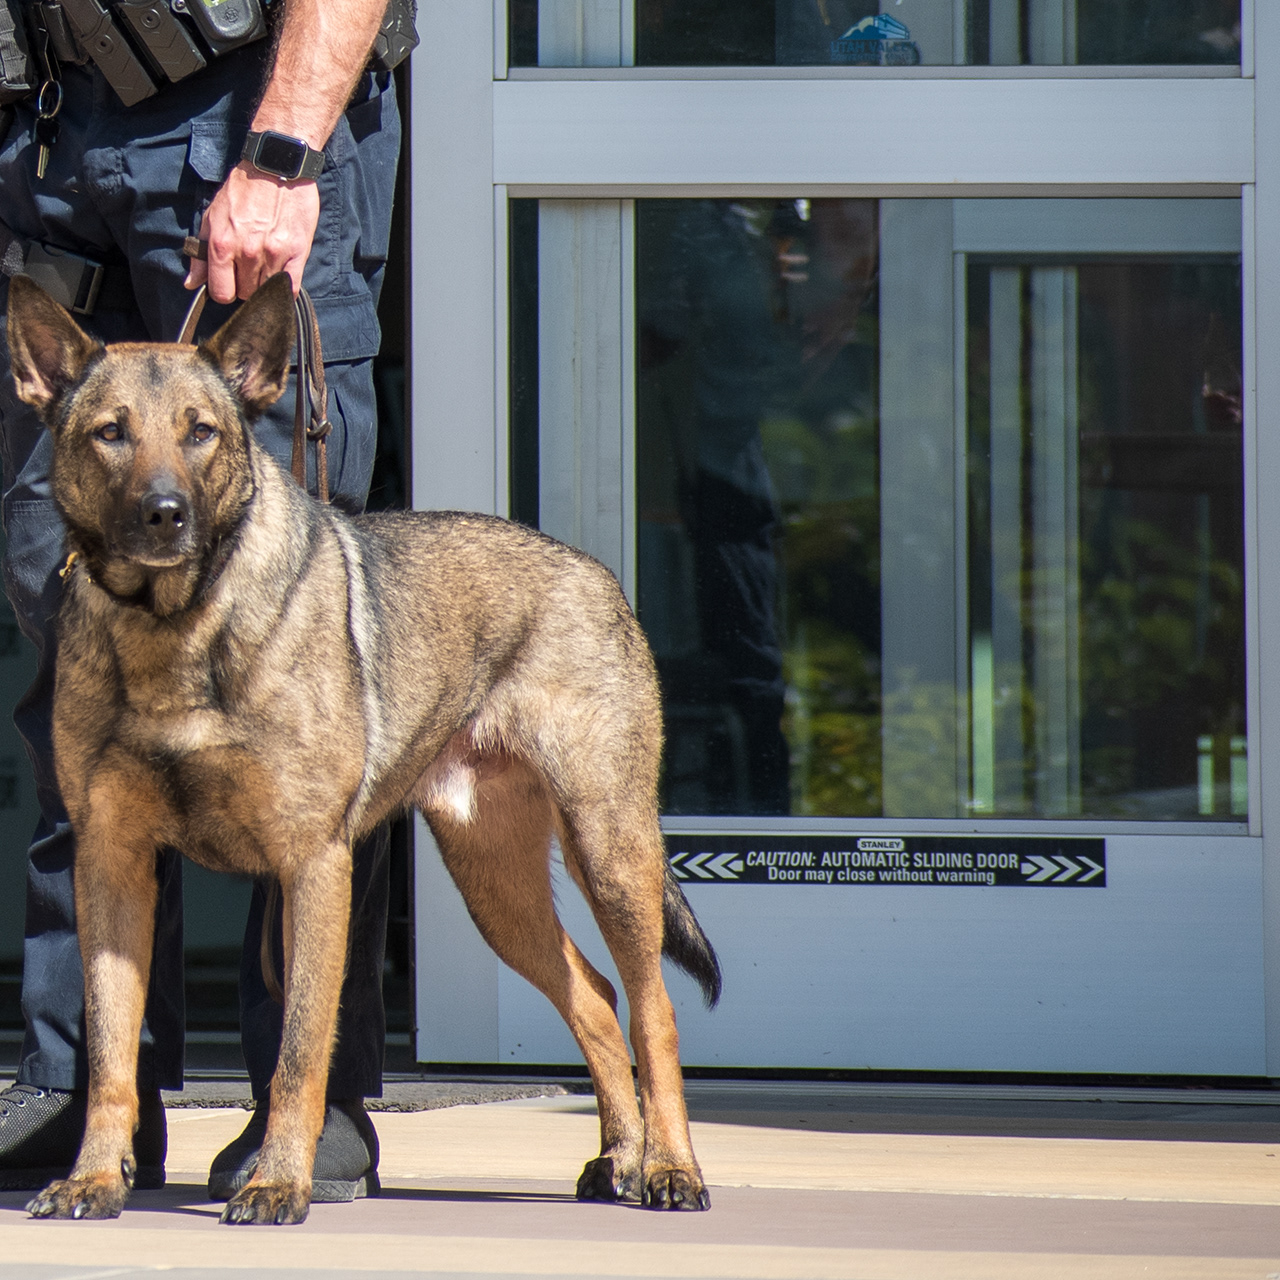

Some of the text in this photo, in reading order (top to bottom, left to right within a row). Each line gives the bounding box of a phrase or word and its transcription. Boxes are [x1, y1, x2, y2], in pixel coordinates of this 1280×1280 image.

[830, 41, 865, 53] UTAH
[860, 841, 901, 849] STANLEY
[746, 851, 1019, 869] CAUTION: AUTOMATIC SLIDING DOOR
[768, 866, 996, 885] Door may close without warning
